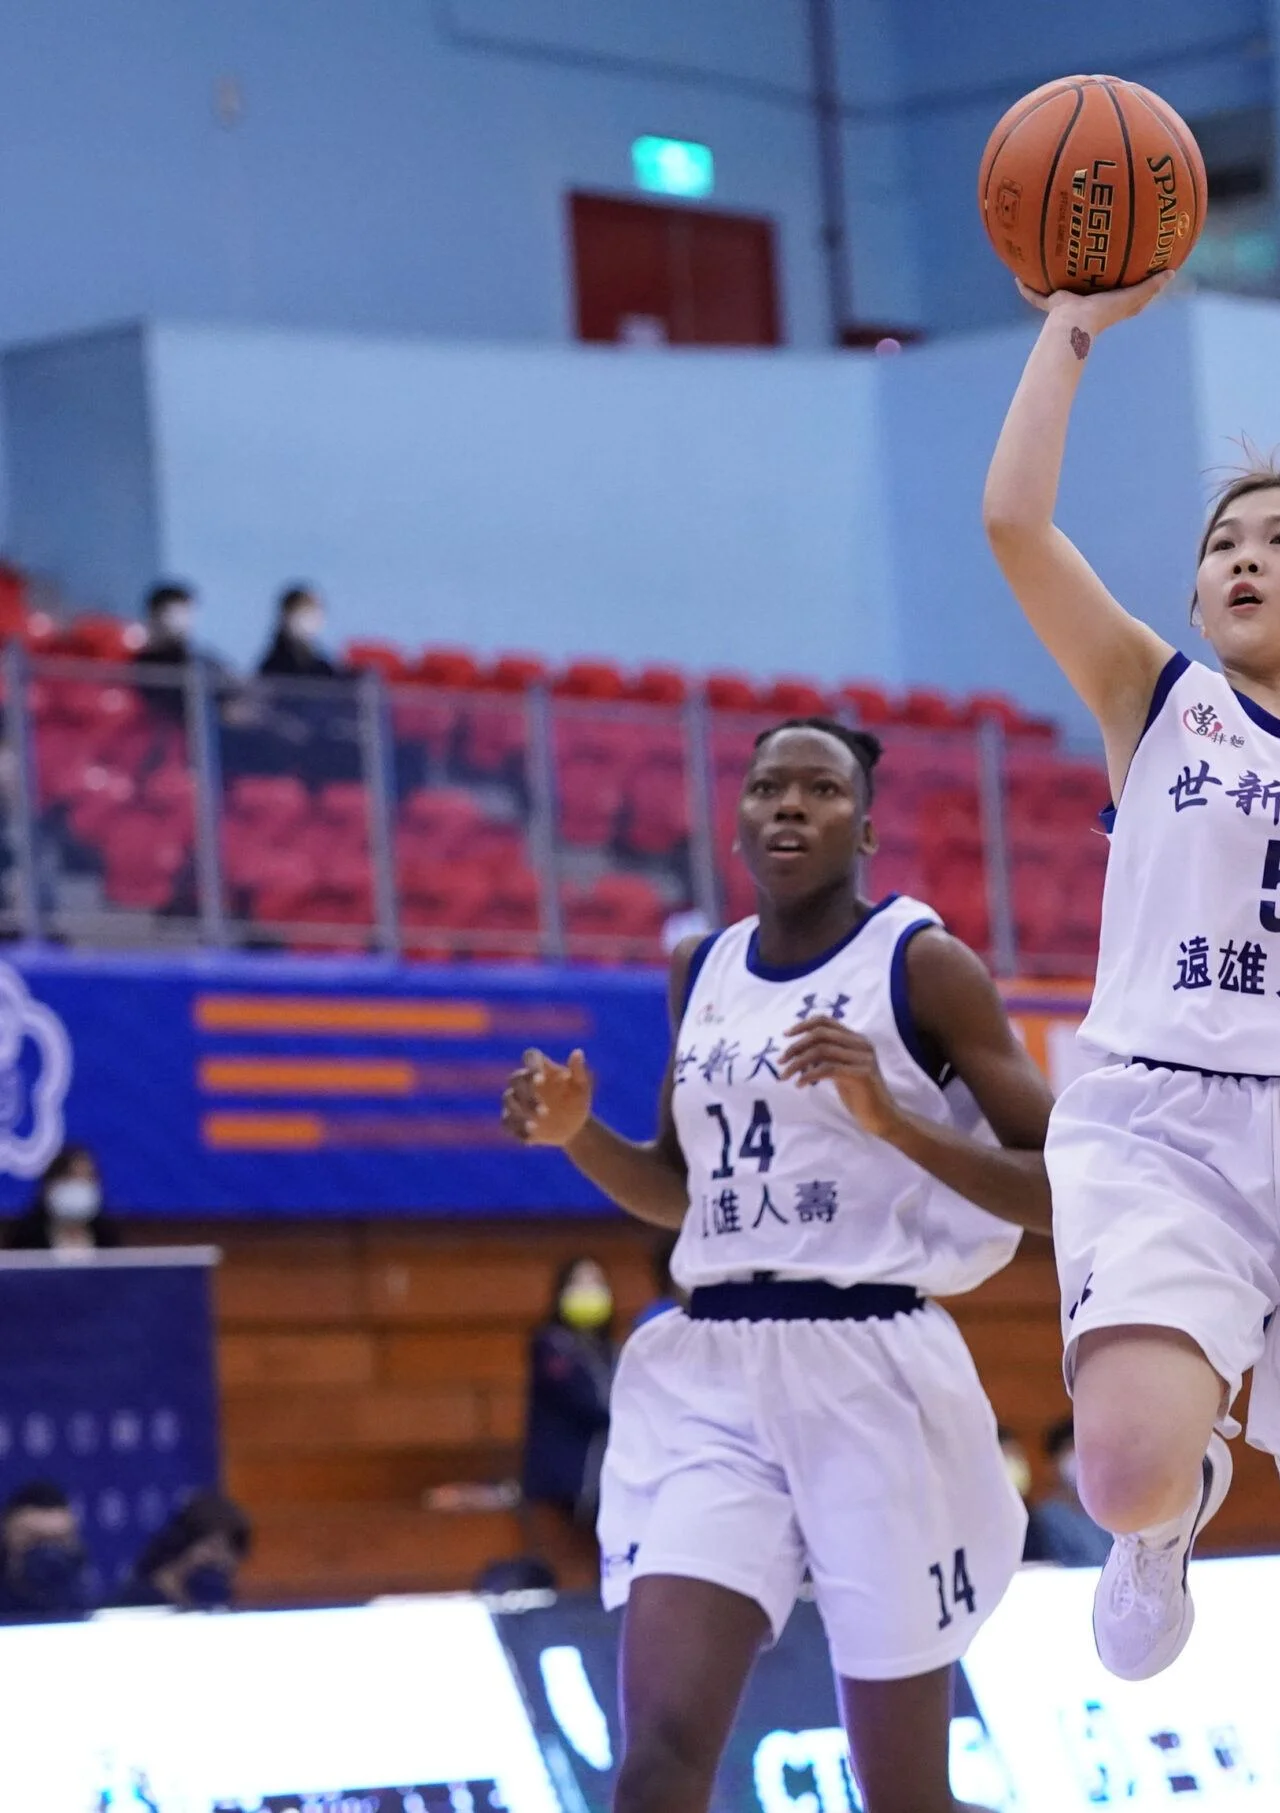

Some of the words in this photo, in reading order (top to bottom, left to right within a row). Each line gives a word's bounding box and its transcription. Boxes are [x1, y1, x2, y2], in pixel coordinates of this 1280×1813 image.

[1083, 159, 1117, 288] LEGACY
[1146, 154, 1178, 274] SPALDIN
[706, 1099, 775, 1180] 14
[929, 1546, 976, 1631] 14
